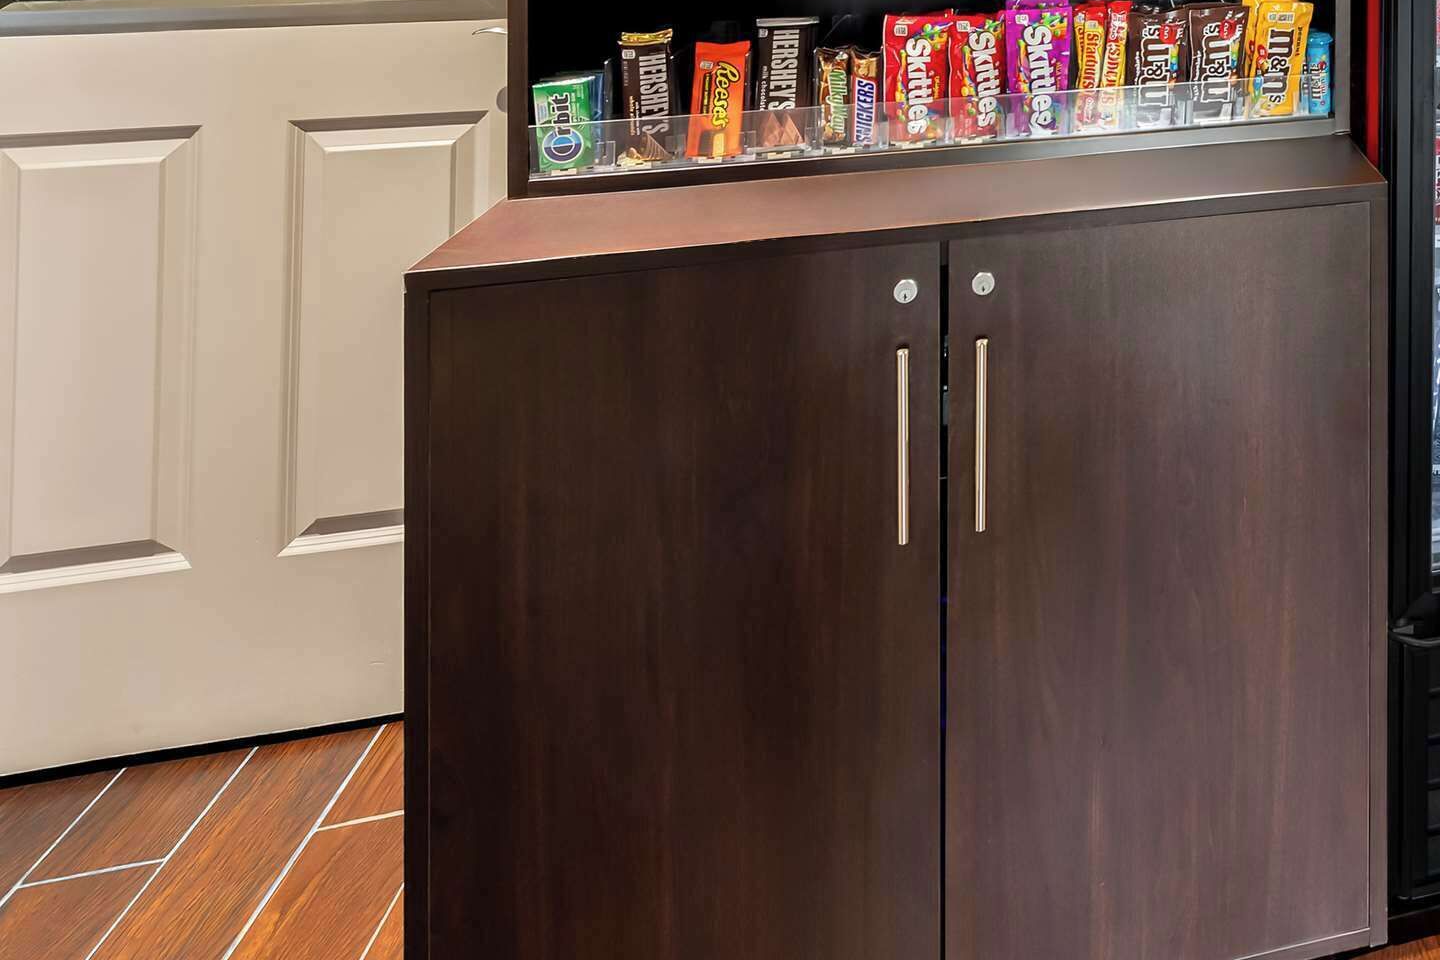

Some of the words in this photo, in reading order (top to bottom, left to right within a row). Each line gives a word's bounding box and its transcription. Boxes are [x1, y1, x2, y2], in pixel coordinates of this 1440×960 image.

[638, 53, 670, 143] HERSHEY'S
[710, 61, 740, 129] Reese's
[758, 81, 768, 112] chocolate
[761, 65, 769, 80] milk
[767, 29, 800, 111] HERSHEY'S
[825, 70, 848, 105] Milky
[904, 38, 934, 135] Skittles
[967, 31, 1000, 128] Skittles
[1022, 25, 1056, 127] Skittles
[1138, 26, 1170, 106] m&m's
[1200, 22, 1231, 102] m&m's
[1262, 28, 1295, 104] m&m's
[828, 103, 847, 133] Way
[855, 79, 876, 145] SNICKERS
